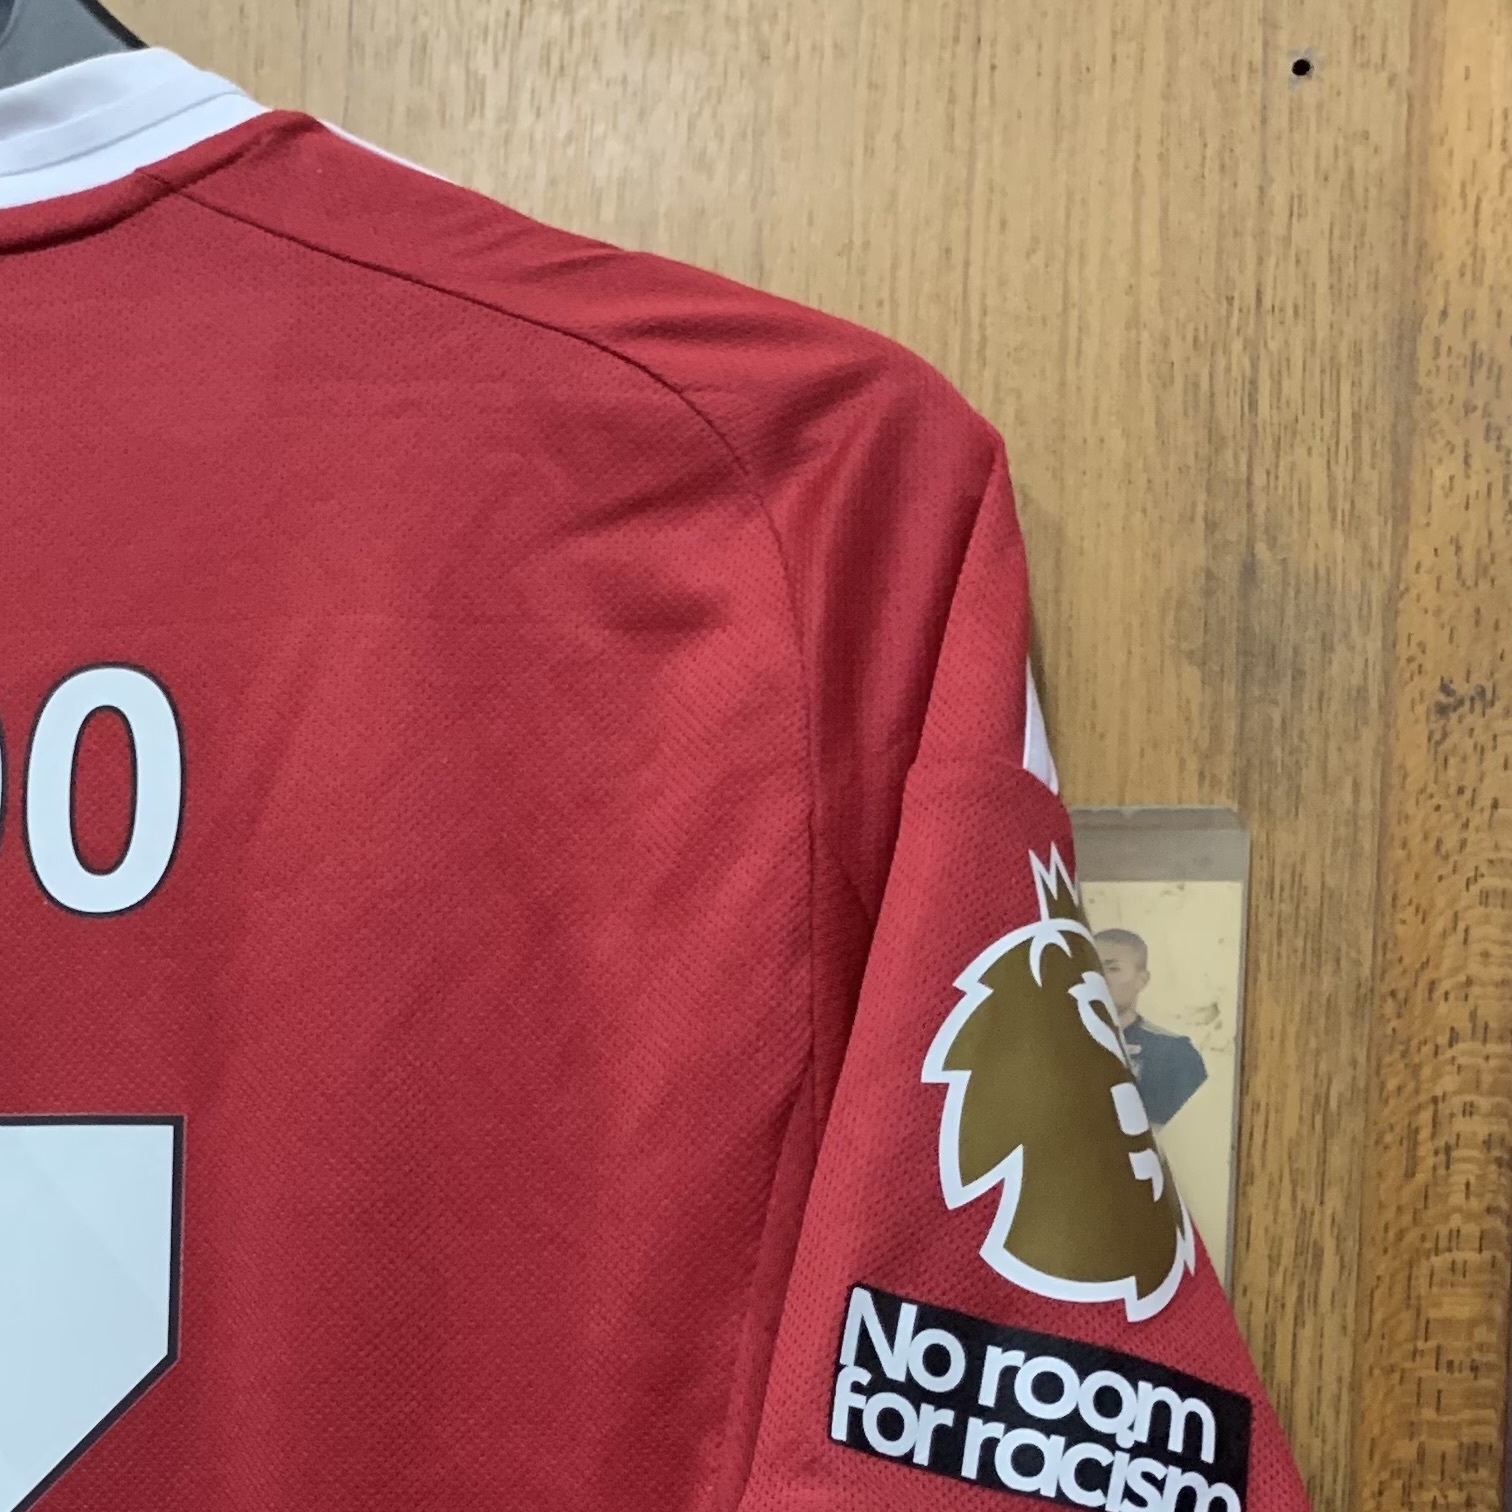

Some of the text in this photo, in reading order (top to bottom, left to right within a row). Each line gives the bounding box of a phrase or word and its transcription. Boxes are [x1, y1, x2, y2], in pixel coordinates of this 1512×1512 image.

[830, 1365, 954, 1467] for
[839, 1286, 1217, 1465] No room
